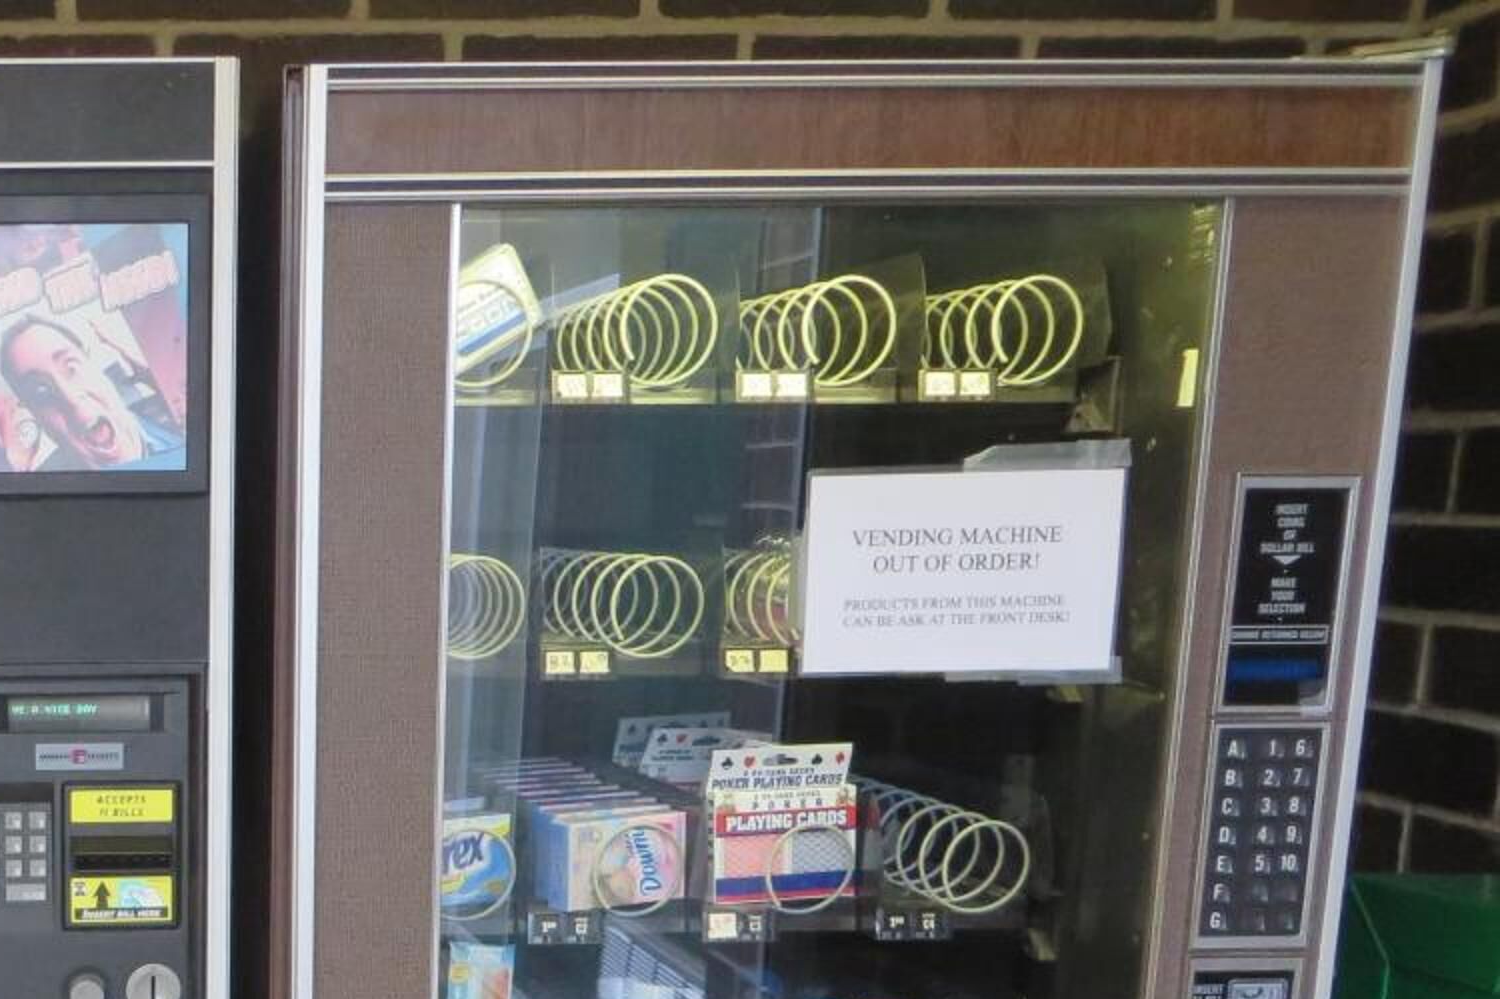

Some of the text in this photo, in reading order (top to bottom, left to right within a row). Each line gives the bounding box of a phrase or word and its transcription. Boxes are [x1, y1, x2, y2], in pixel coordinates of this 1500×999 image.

[852, 525, 1063, 547] VENDING MACHINE
[873, 552, 1040, 573] OUT OF ORDER!
[845, 594, 1065, 611] PRODUCTS FROM THIS MACHINE
[843, 610, 1071, 627] CAN BE ASK AT THE FRONT DESK!
[1226, 739, 1238, 758] A
[1268, 739, 1277, 757] 1
[1295, 739, 1305, 757] 6
[753, 775, 802, 788] PLAYING
[806, 773, 843, 785] CARDS
[1224, 769, 1236, 787] B
[1263, 769, 1274, 785] 2
[1293, 768, 1303, 784] 7
[1221, 798, 1232, 816] C
[1260, 797, 1271, 814] 3
[1289, 796, 1300, 813] 8
[726, 810, 846, 832] PLAYING CARDS
[1218, 826, 1230, 844] D
[1257, 826, 1267, 843] 4
[1286, 825, 1297, 843] 9
[636, 829, 661, 893] Downy
[1216, 855, 1227, 873] E
[1254, 854, 1264, 872] 5
[1281, 855, 1297, 872] 10
[1213, 883, 1224, 901] F
[1209, 911, 1221, 929] G
